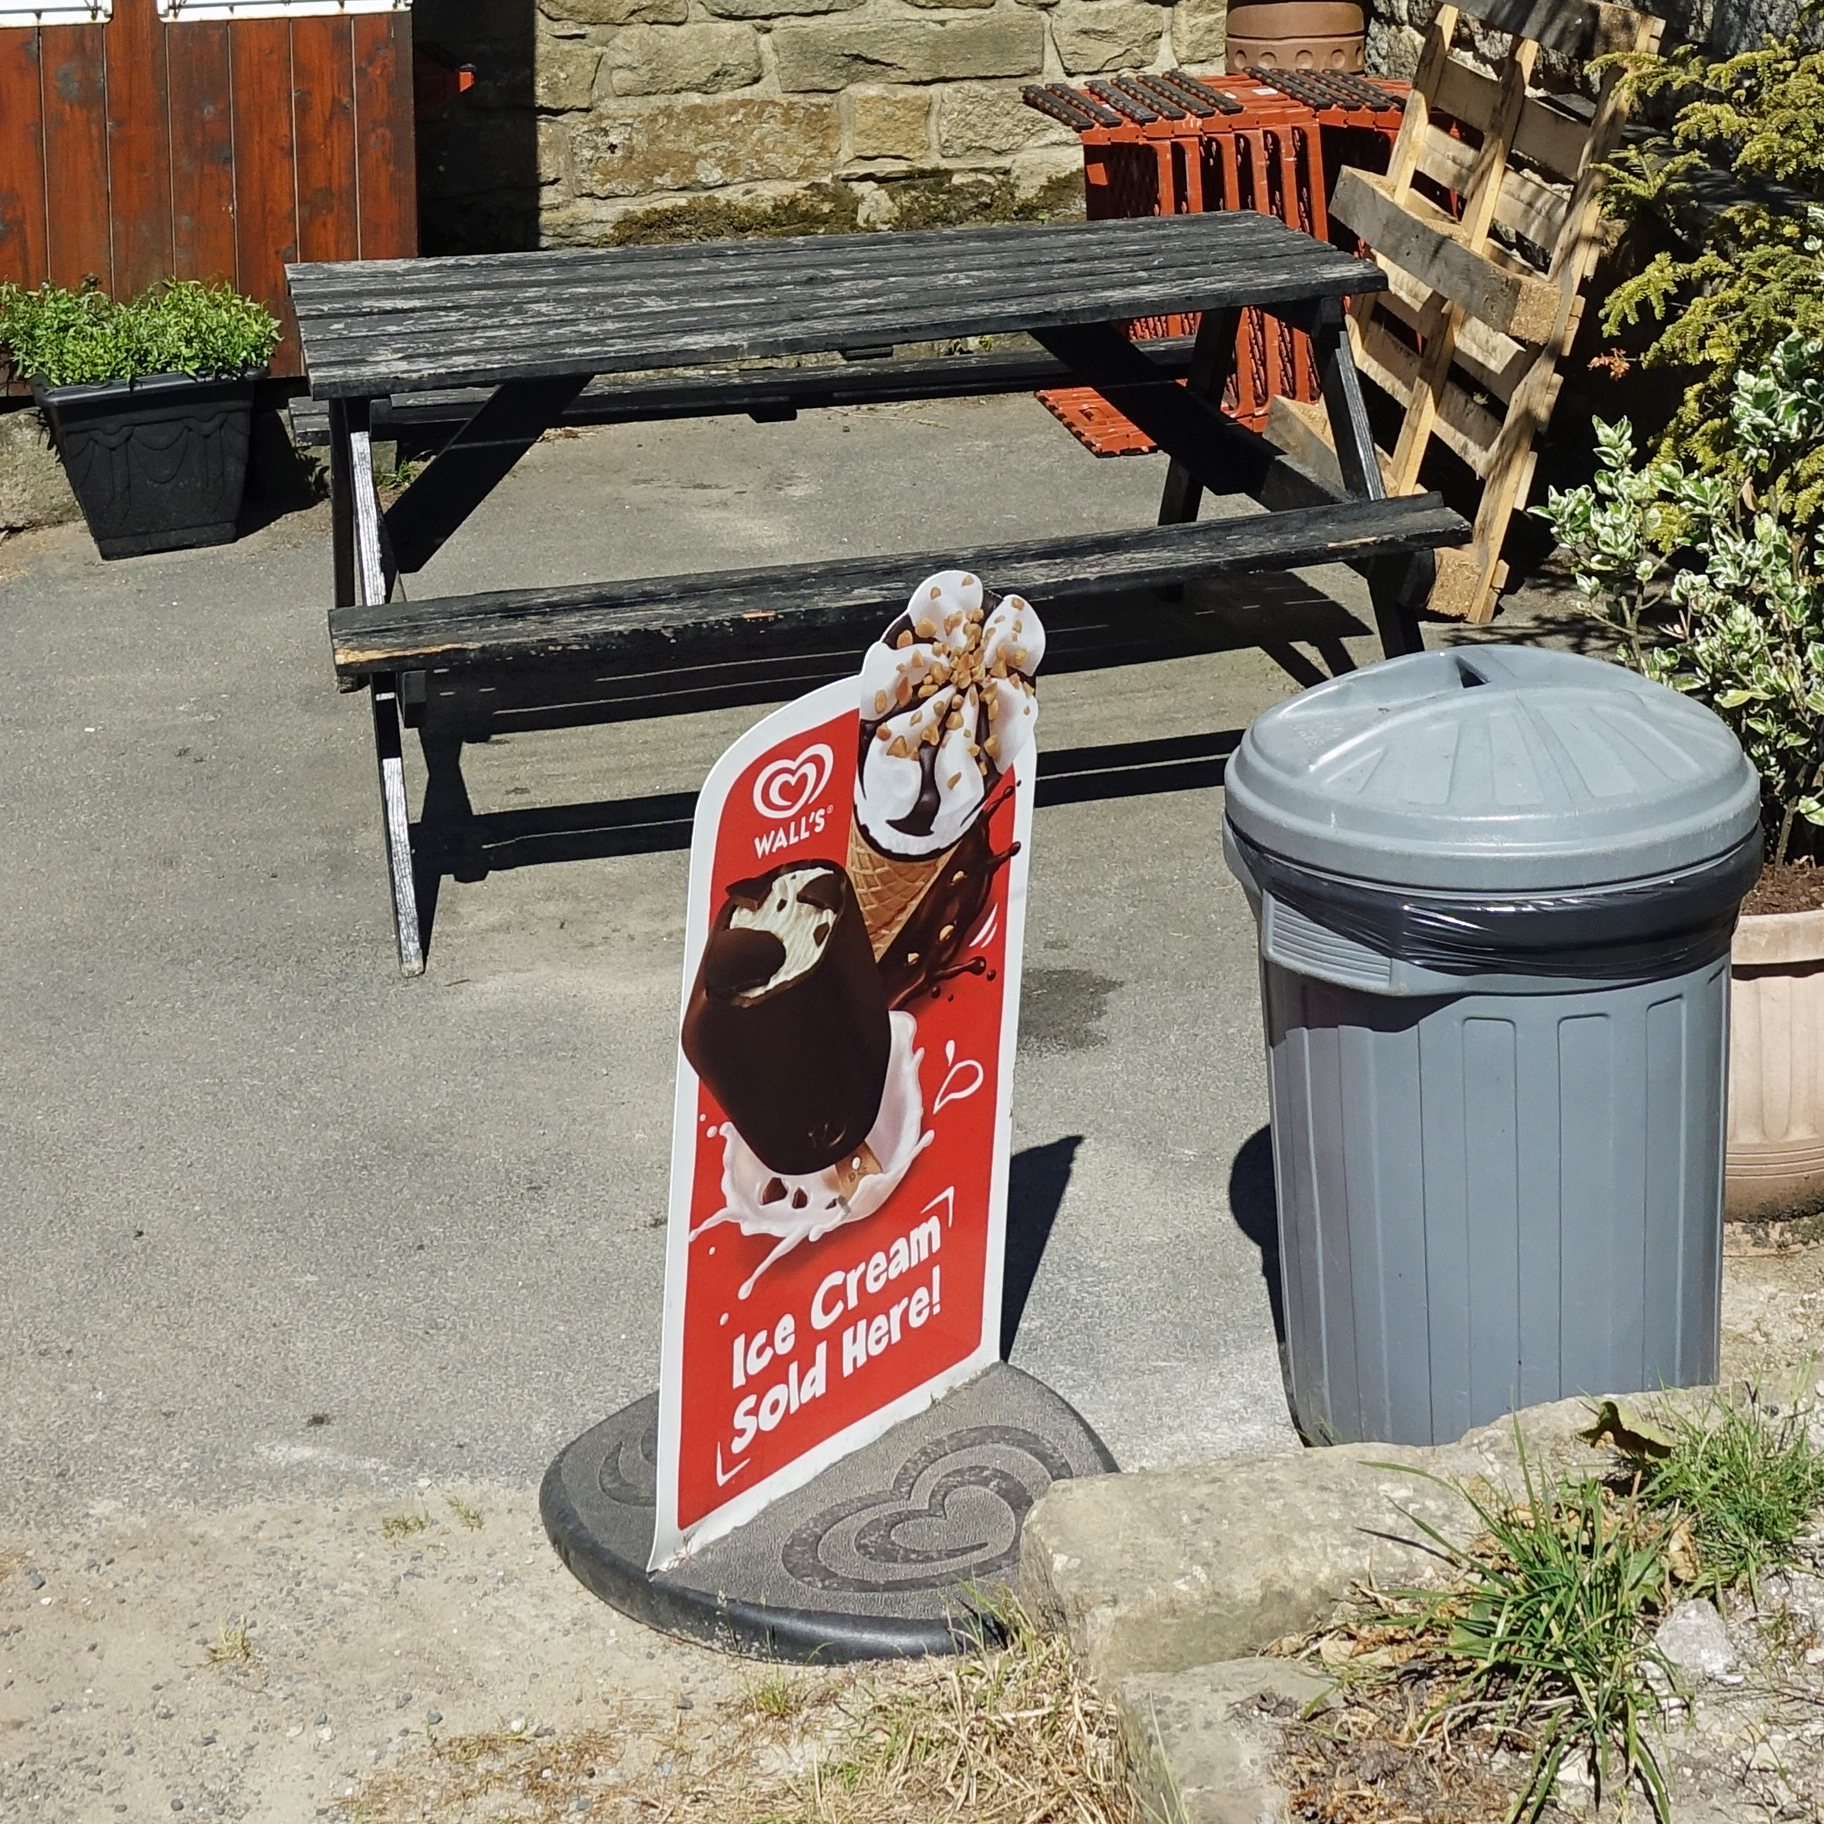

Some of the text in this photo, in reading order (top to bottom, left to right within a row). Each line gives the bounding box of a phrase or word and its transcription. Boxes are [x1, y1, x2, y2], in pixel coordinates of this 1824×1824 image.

[754, 808, 826, 860] WALL'S
[731, 1264, 941, 1454] Sold Here!
[732, 1215, 941, 1389] Ice Cream
